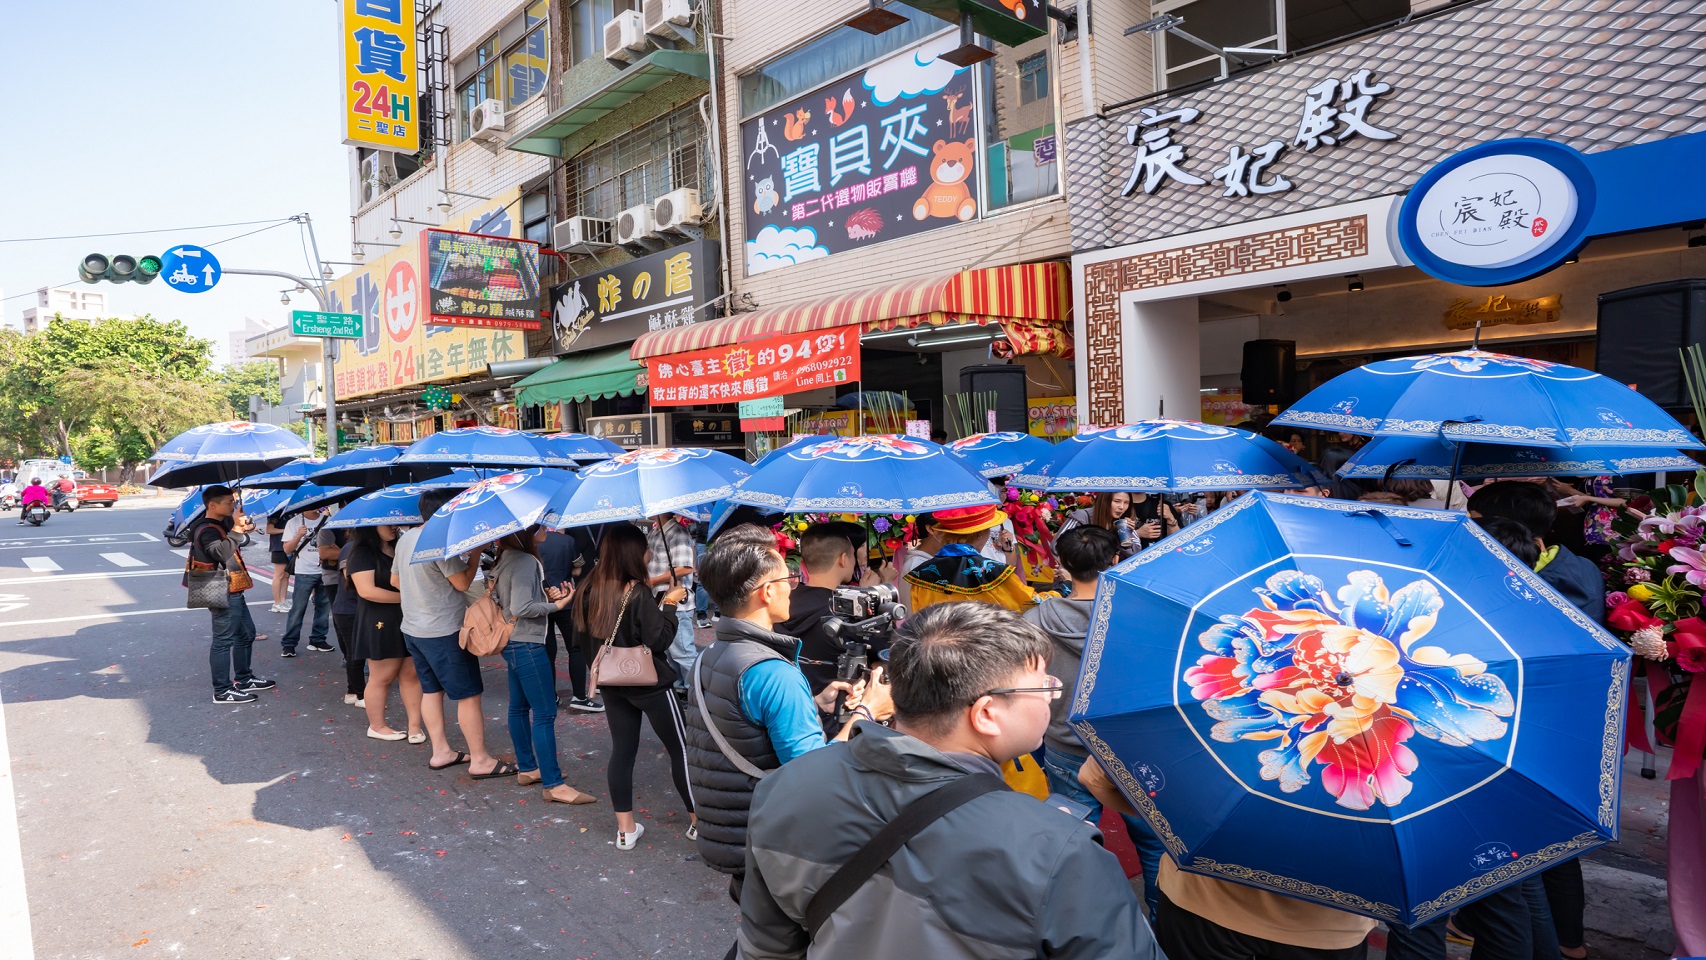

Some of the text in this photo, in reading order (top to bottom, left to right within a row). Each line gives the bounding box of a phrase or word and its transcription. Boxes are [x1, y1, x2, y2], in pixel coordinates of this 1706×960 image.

[352, 80, 411, 122] 24H
[358, 118, 407, 138] 二聖店
[1121, 68, 1399, 198] 宸妃殿
[780, 103, 930, 203] 寶貝夾
[791, 165, 918, 222] 第二代選物販賣機
[933, 195, 958, 203] TEDDY
[1431, 230, 1449, 238] CHEN
[302, 314, 354, 325] 二聖二路
[302, 324, 332, 335] Ersheng
[332, 326, 343, 334] 2nd
[796, 372, 833, 387] Line 同上
[740, 404, 757, 416] TEL
[1028, 404, 1077, 420] OY STO
[818, 417, 849, 429] STORY
